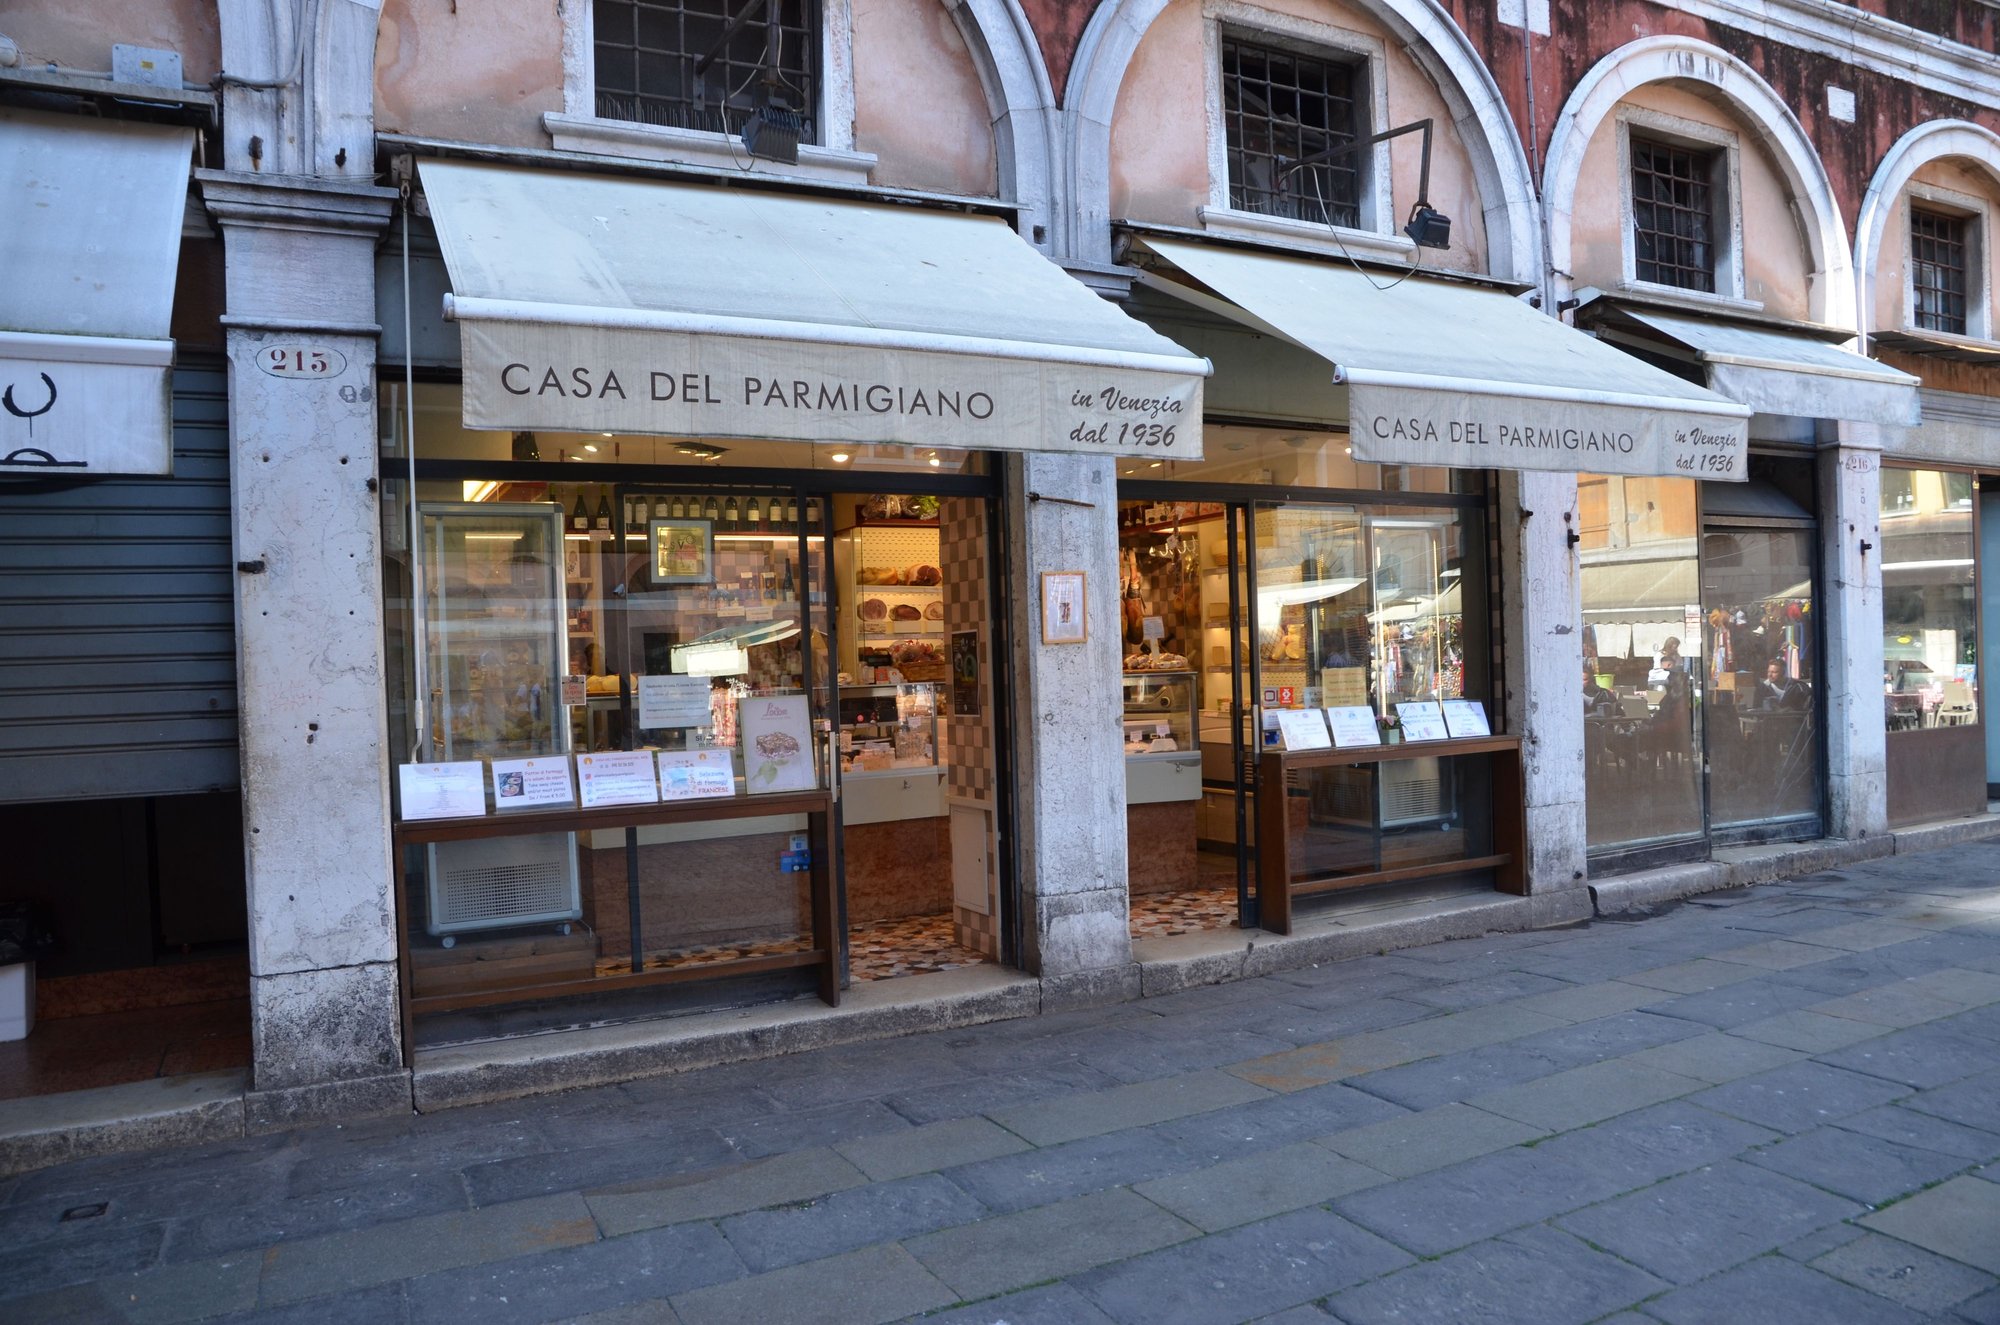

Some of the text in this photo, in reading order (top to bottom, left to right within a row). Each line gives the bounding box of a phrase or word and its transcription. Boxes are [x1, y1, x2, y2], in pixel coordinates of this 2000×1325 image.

[270, 349, 327, 372] 215
[501, 363, 994, 420] CASA DEL PARMIGIANO
[1071, 386, 1184, 420] in Venezia
[1069, 421, 1177, 447] dal 1936
[1373, 416, 1634, 453] CASA DEL PARMIGIANO
[1674, 427, 1737, 451] in Venezia
[1676, 453, 1734, 472] dal 1936
